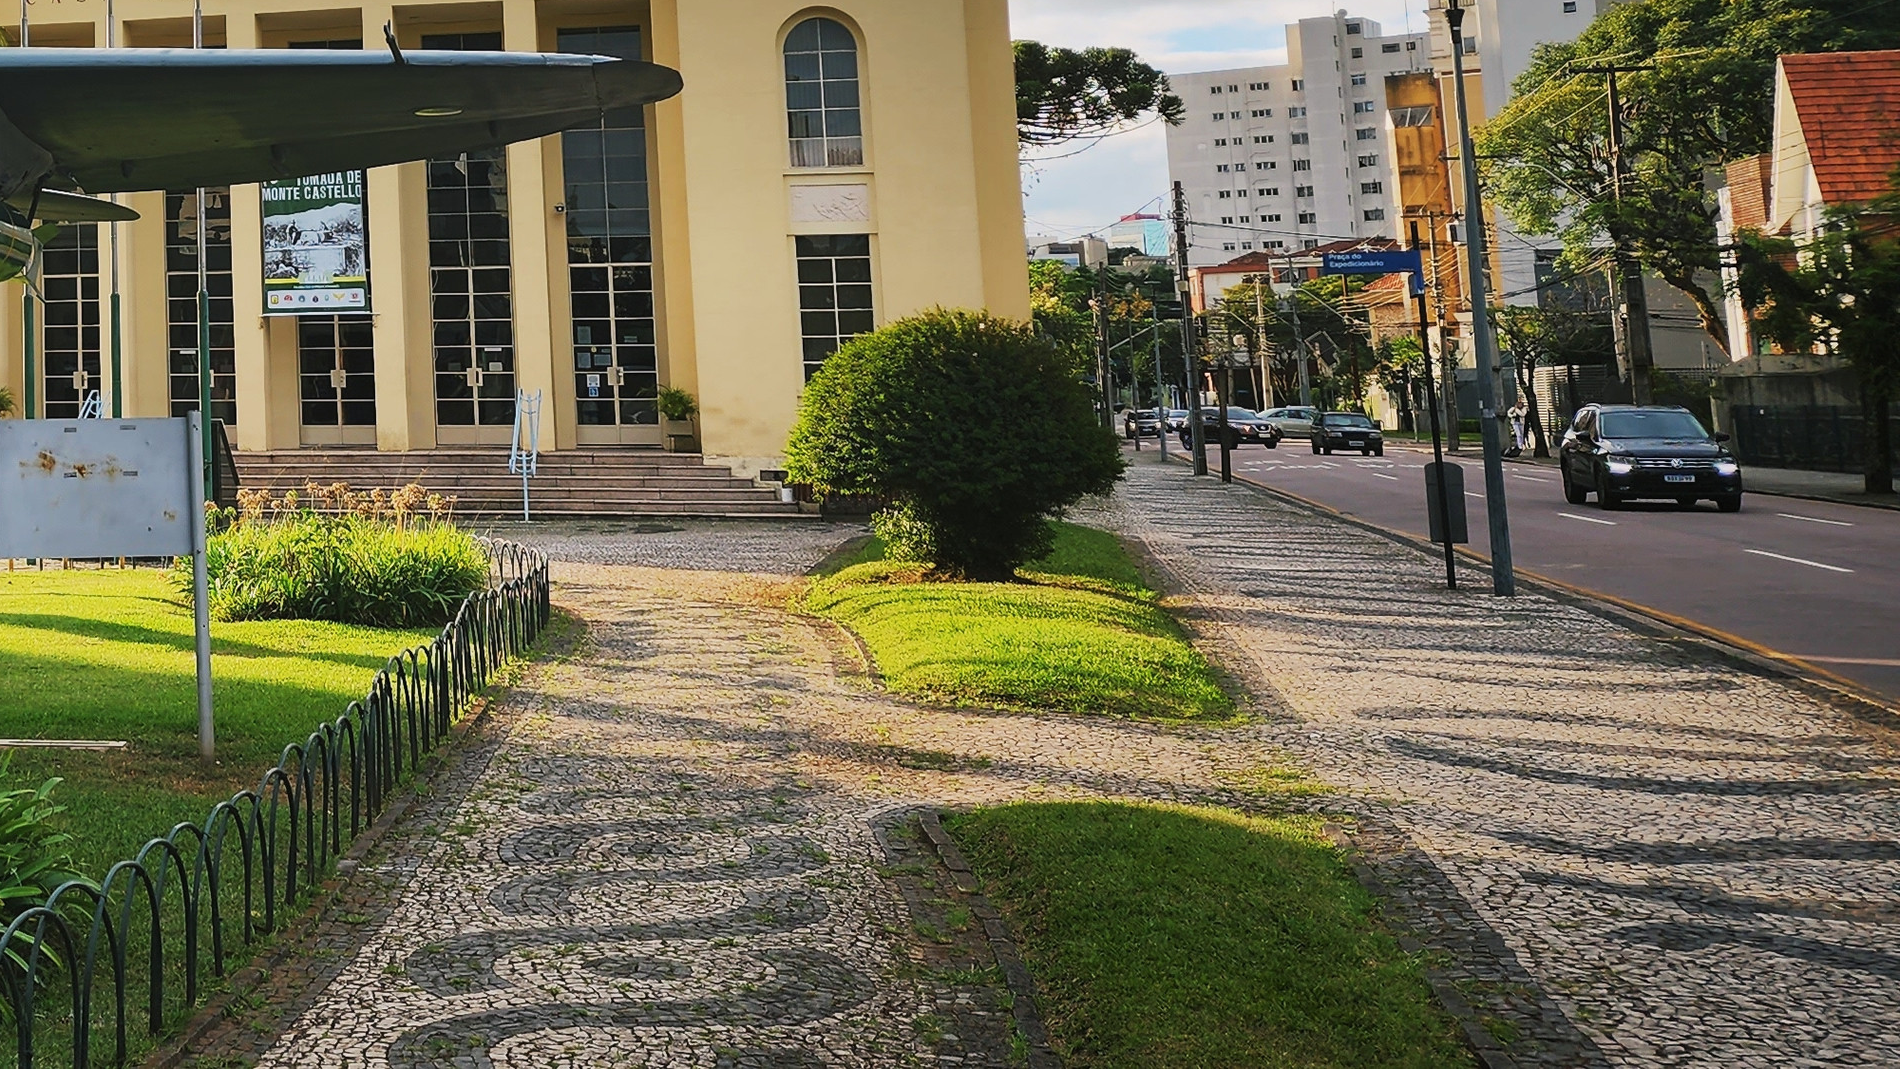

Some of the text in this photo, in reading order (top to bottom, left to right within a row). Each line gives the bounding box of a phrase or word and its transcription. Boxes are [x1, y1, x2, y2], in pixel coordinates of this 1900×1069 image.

[347, 170, 361, 184] DE
[262, 185, 362, 201] MONTE CASTELLO
